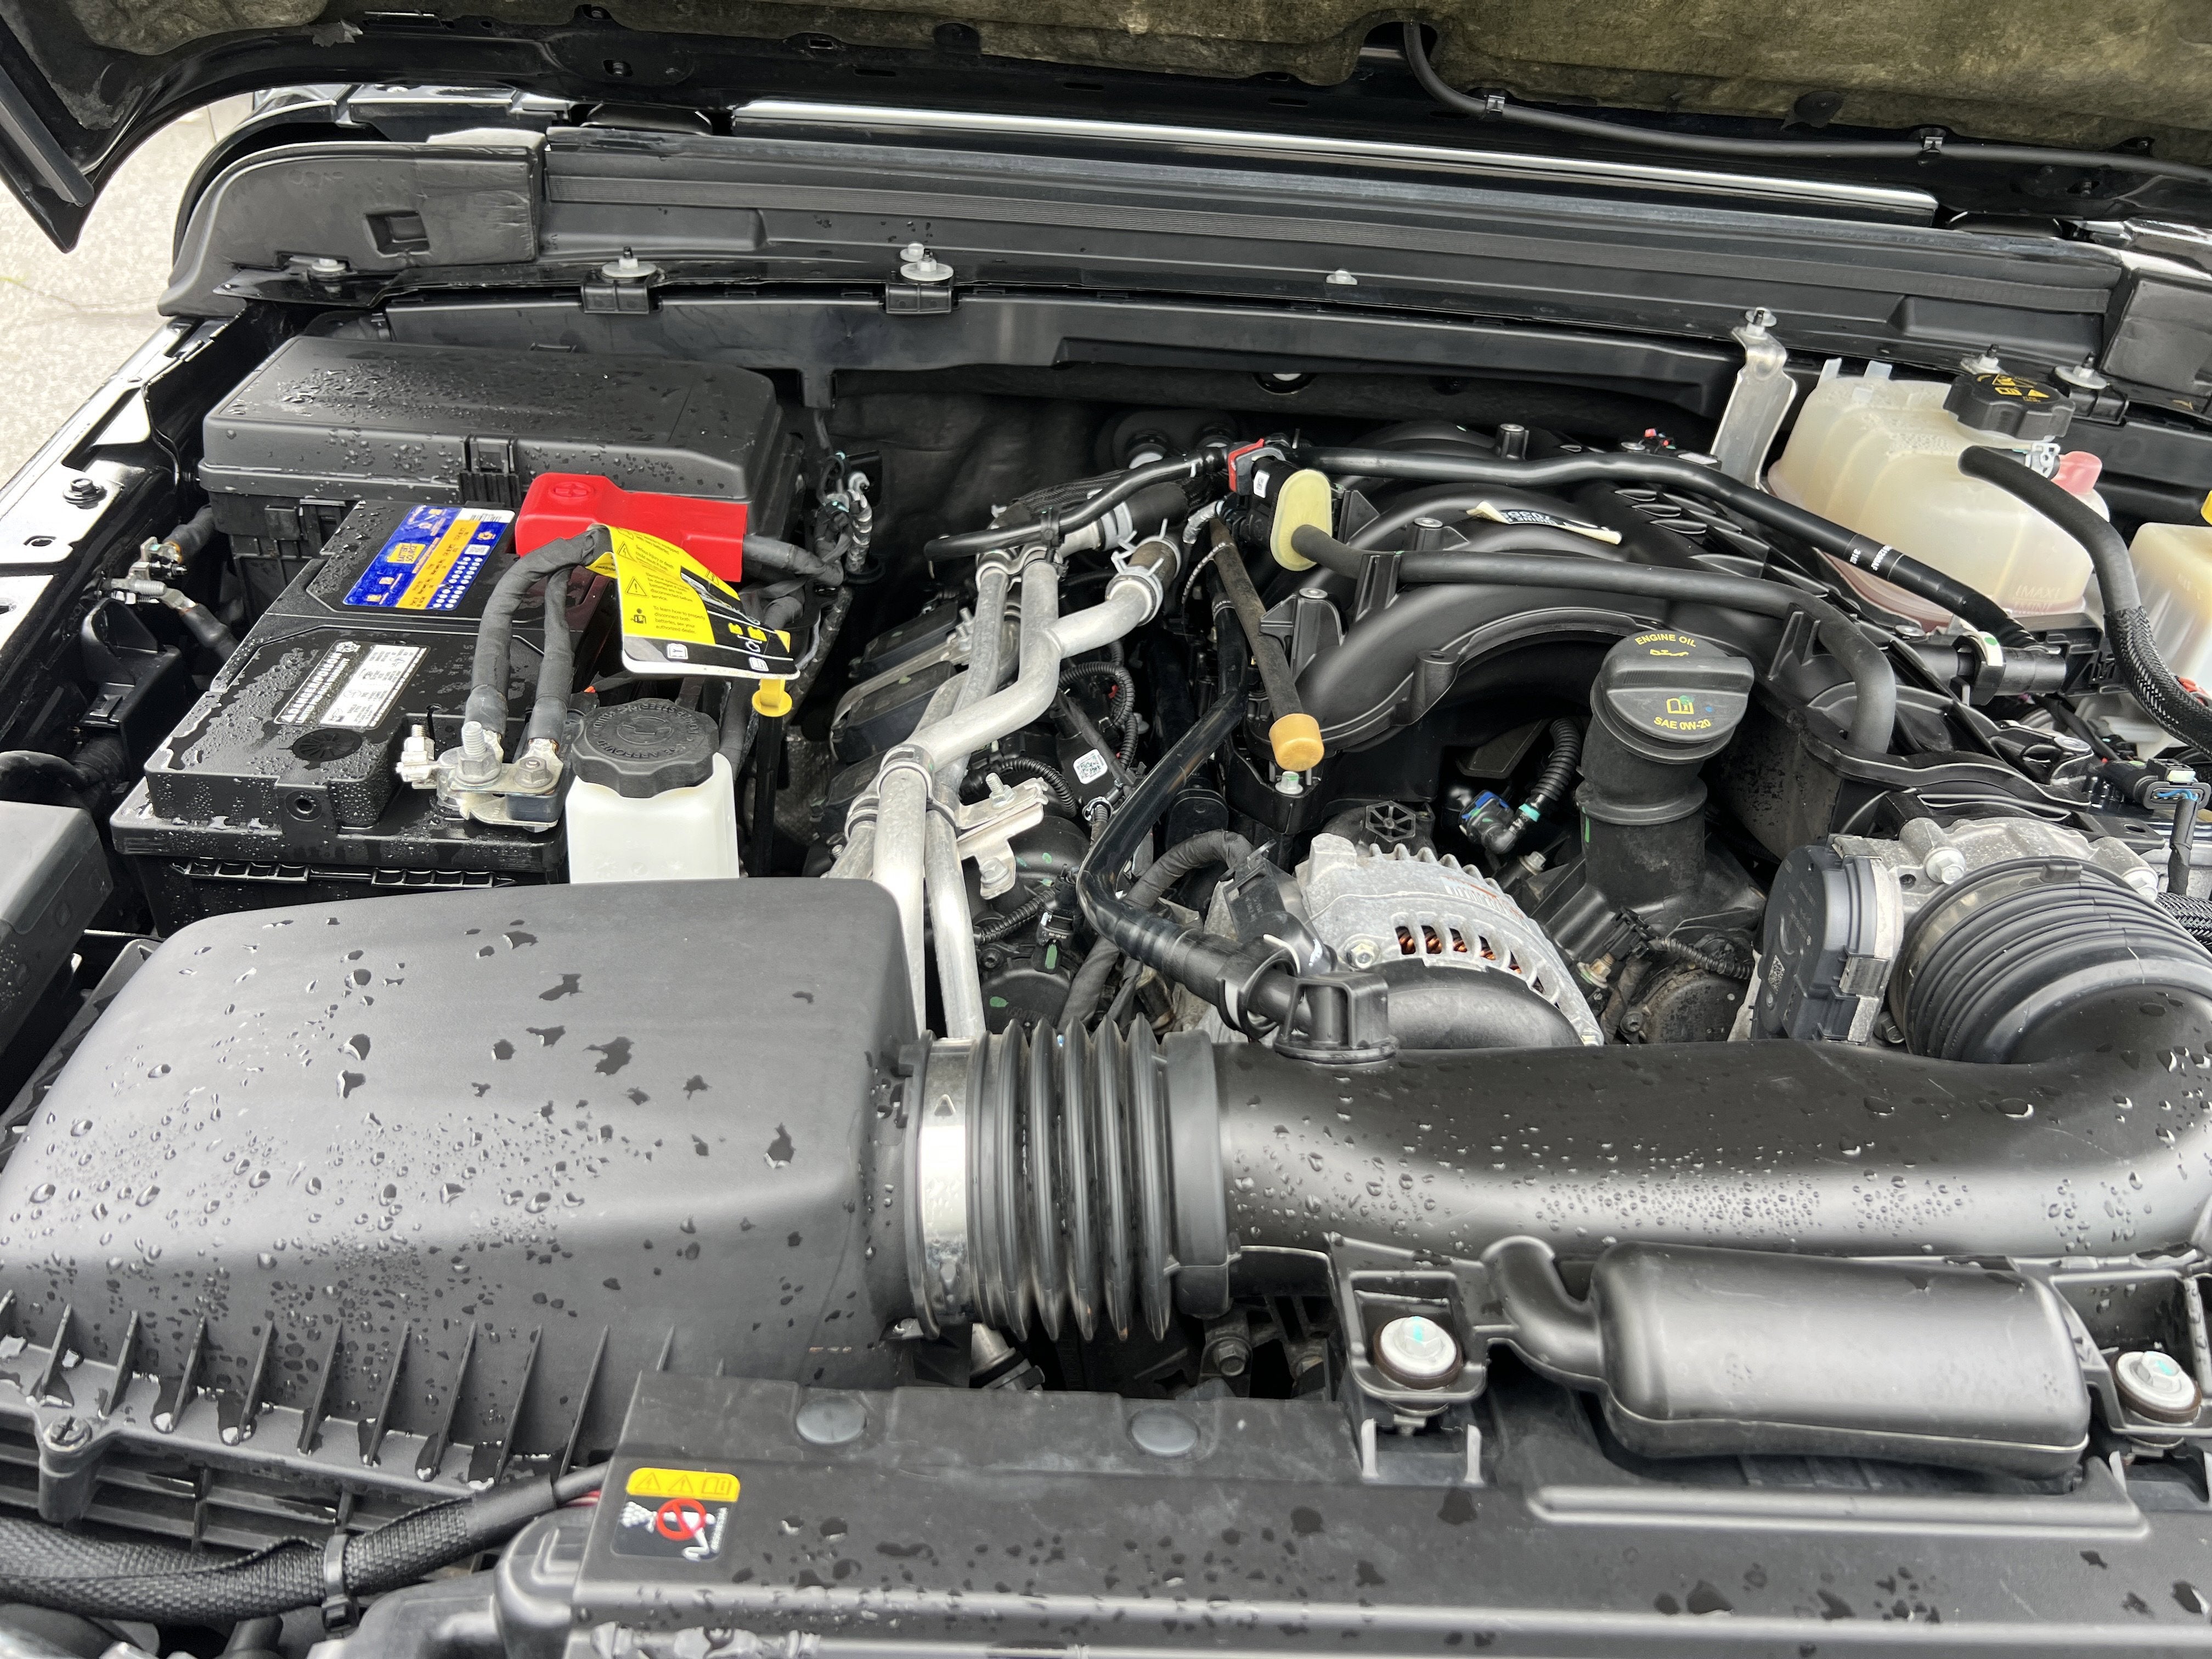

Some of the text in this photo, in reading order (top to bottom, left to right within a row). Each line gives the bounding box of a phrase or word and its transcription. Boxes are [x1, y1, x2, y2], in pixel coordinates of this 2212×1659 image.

[1634, 634, 1697, 647] ENGINE OIL
[288, 651, 342, 715] DANGER/POISON
[618, 703, 676, 714] STEERING
[1654, 716, 1711, 730] SAE 0W-20
[597, 740, 659, 759] APPROVED
